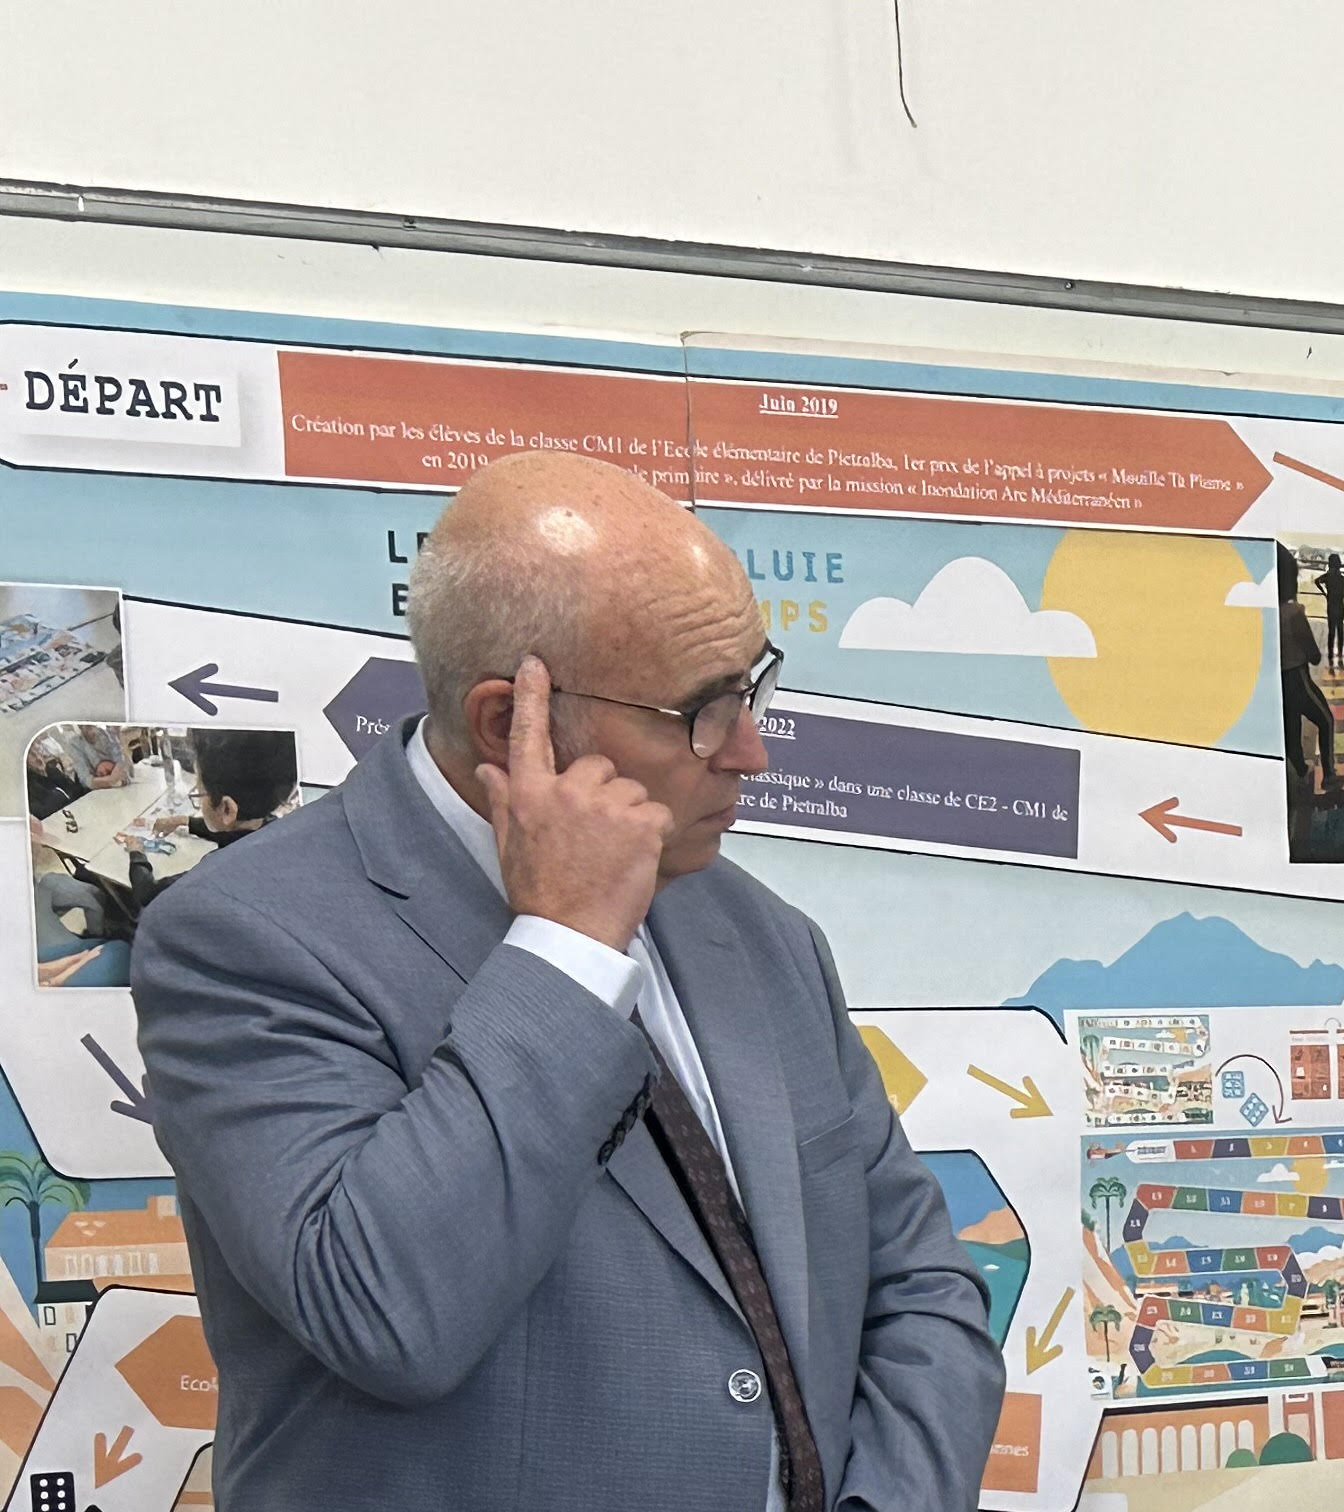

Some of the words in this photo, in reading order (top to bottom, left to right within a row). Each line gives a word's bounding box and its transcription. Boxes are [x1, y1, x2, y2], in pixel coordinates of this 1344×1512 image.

[25, 358, 223, 424] DÉPART
[760, 394, 796, 413] Juin
[800, 397, 838, 417] 2019
[291, 414, 365, 437] Création
[370, 421, 396, 441] par
[401, 421, 425, 441] les
[429, 423, 480, 445] élèves
[486, 427, 506, 446] de
[510, 429, 524, 448] la
[530, 430, 578, 451] classe
[583, 435, 623, 455] CM1
[629, 437, 647, 457] de
[712, 441, 801, 465] élémentaire
[806, 448, 823, 465] de
[963, 458, 981, 475] de
[984, 458, 1032, 481] l'appel
[1037, 463, 1045, 479] à
[1048, 465, 1096, 485] projets
[422, 455, 442, 470] en
[742, 468, 794, 490] délivré
[799, 477, 823, 493] par
[828, 474, 842, 491] la
[846, 477, 904, 496] mission
[921, 480, 998, 501] Inondation
[747, 548, 845, 585] LUIE
[760, 792, 777, 810] de
[782, 795, 848, 819] Pietralba
[829, 776, 862, 796] dans
[867, 784, 893, 799] une
[897, 785, 940, 806] classe
[944, 791, 961, 808] de
[965, 793, 997, 812] CE2
[1013, 799, 1046, 819] CM1
[1052, 803, 1068, 822] de
